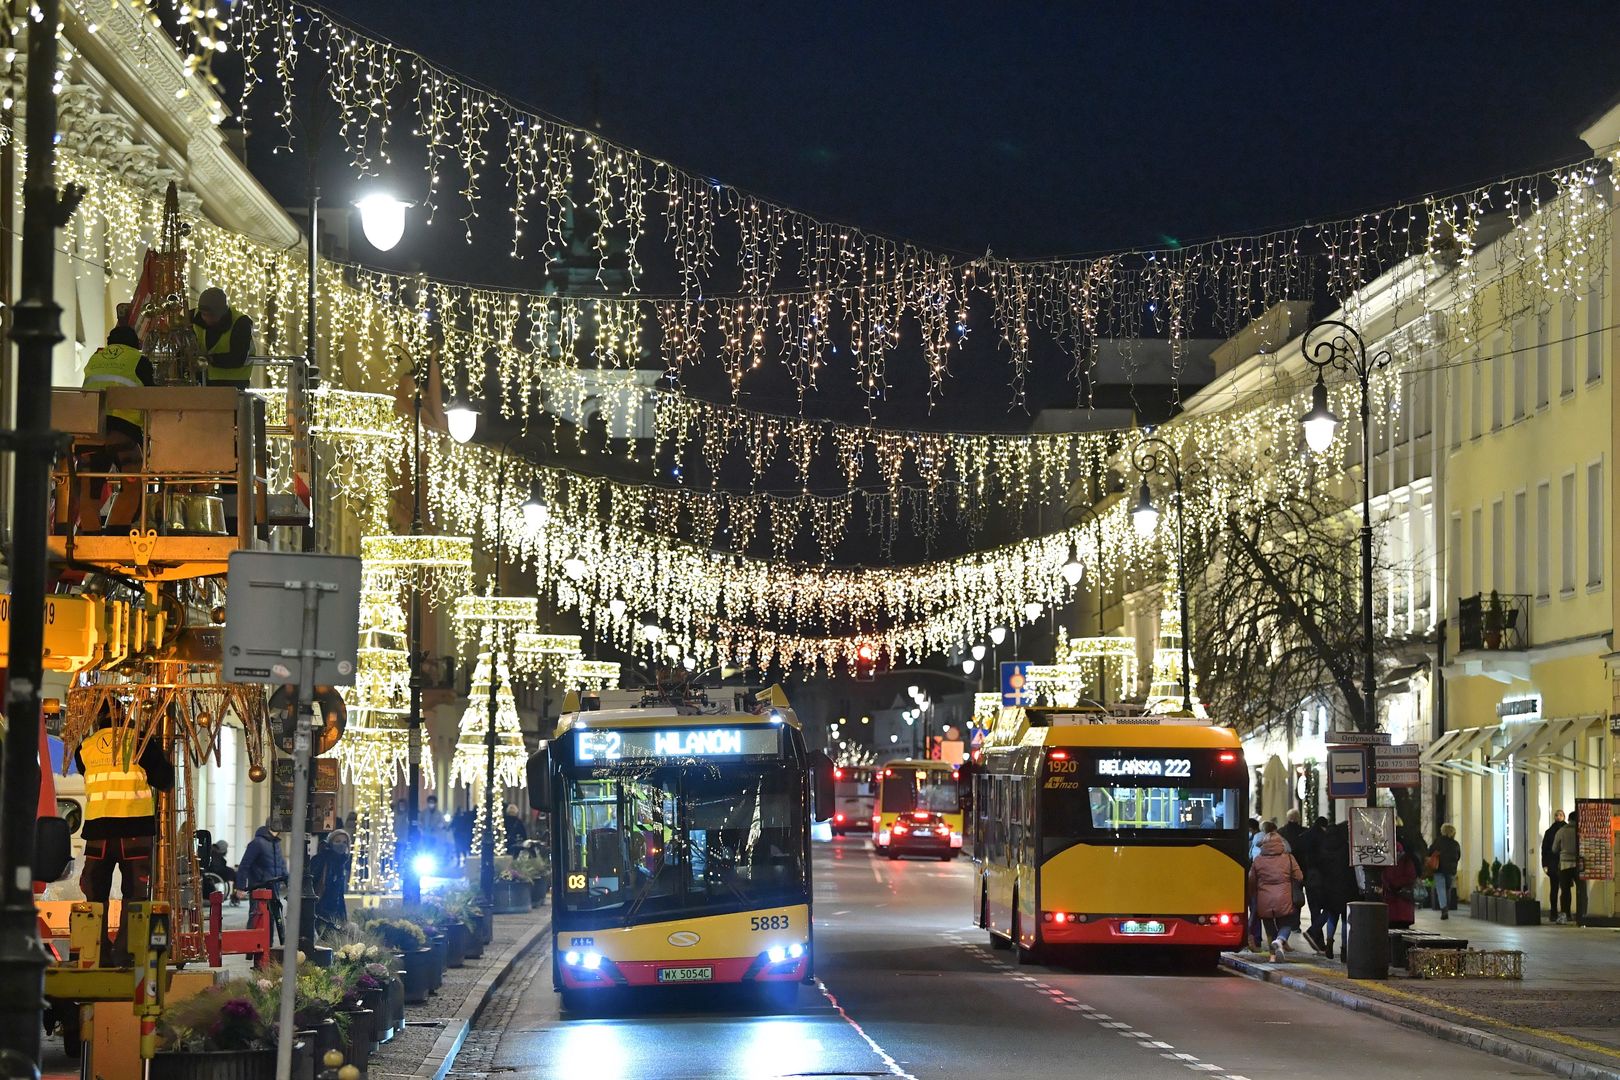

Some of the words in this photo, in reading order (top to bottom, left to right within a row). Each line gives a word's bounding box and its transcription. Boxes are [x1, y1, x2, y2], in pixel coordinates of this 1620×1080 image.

[578, 732, 621, 760] E-2
[1341, 735, 1380, 743] Ordynacka
[1047, 760, 1078, 773] 1920
[1164, 759, 1191, 777] 222
[568, 874, 586, 889] 03
[750, 915, 789, 931] 5883
[664, 969, 677, 979] WX
[680, 968, 710, 979] 5054C
